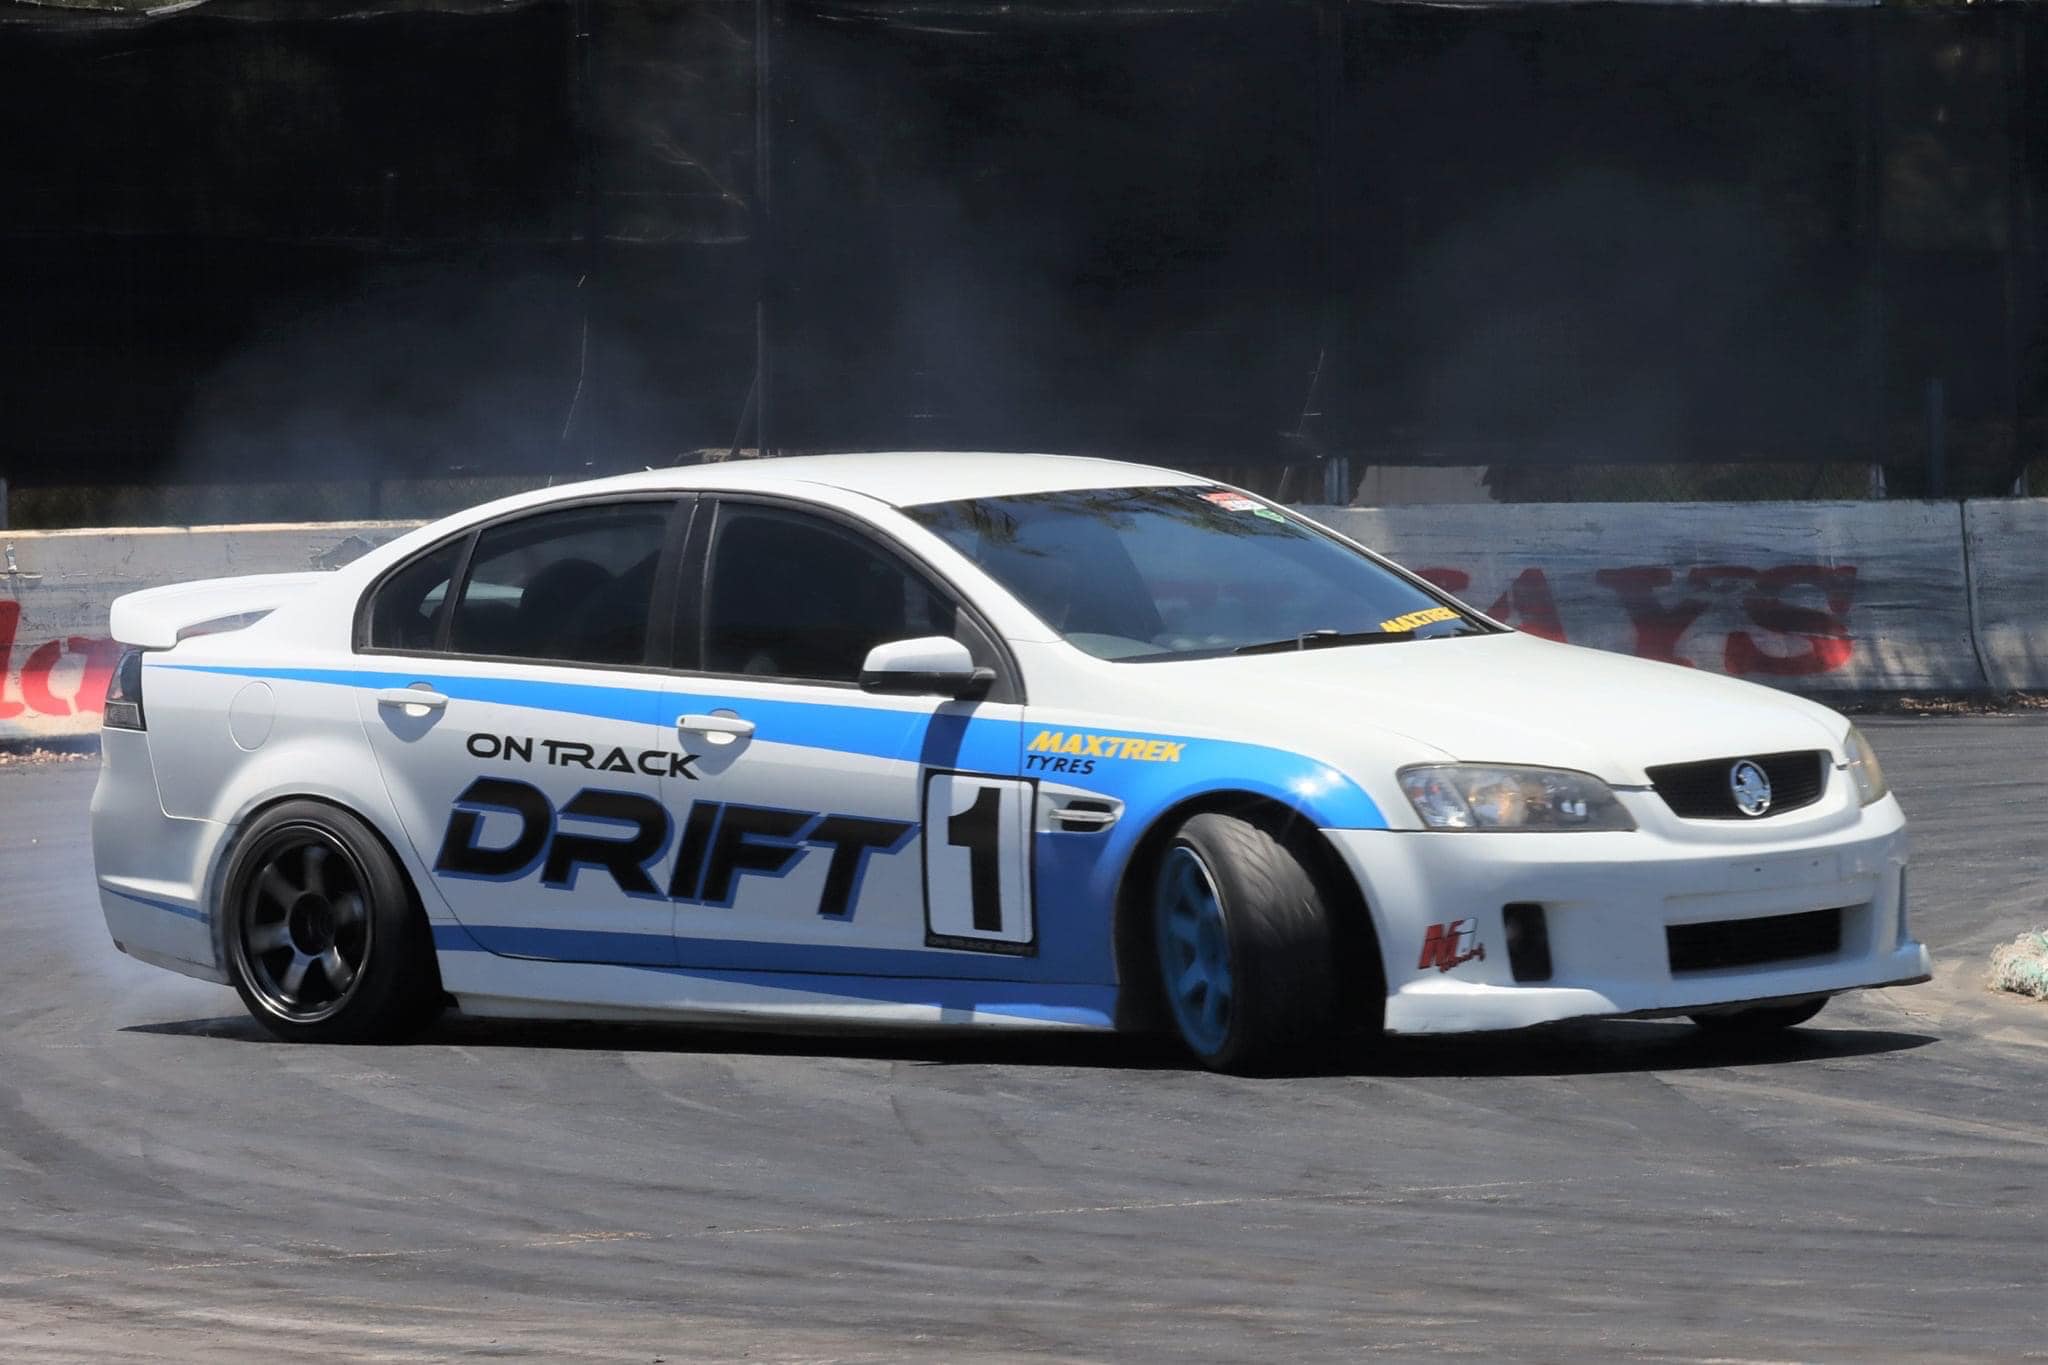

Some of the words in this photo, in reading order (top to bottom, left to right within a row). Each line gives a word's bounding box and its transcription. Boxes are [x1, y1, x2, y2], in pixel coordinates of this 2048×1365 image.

[1413, 566, 1857, 676] AYS
[466, 733, 533, 763] ON
[541, 739, 702, 781] TRACK
[1026, 754, 1097, 775] TYRES
[1028, 730, 1187, 762] MAXTREK
[433, 775, 922, 923] DRIFT
[947, 786, 1003, 932] 1
